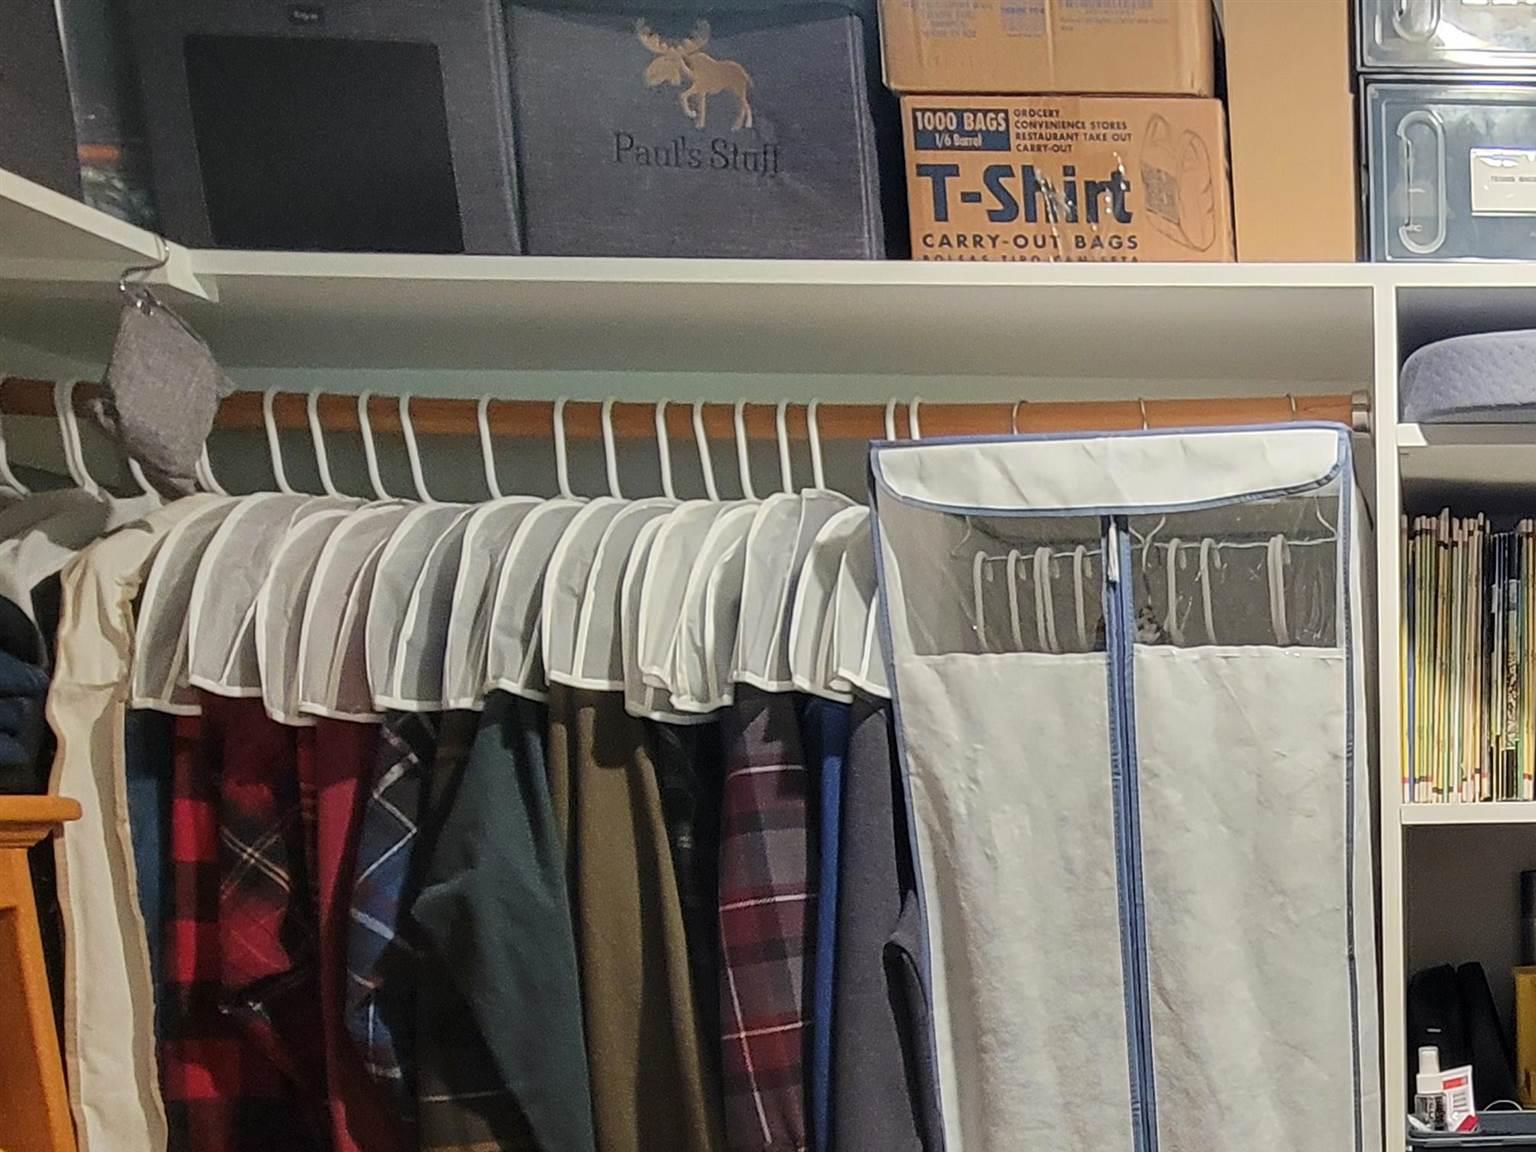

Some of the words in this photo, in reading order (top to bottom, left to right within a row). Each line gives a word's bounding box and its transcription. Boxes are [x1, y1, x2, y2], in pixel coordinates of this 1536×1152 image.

[1013, 109, 1060, 118] GROCERY
[915, 111, 957, 131] 1000
[963, 112, 1007, 132] BAGS
[1014, 120, 1086, 130] CONVENIENCE
[1090, 121, 1127, 130] STORES
[935, 133, 951, 148] 1/6
[1015, 131, 1080, 142] RESTAURANT
[1082, 132, 1107, 142] TAKE
[1110, 132, 1133, 142] OUT
[614, 131, 702, 168] Paul's
[710, 138, 780, 178] Stuff
[1016, 143, 1073, 153] CARRY-OUT
[915, 164, 1134, 224] T-Shirt
[922, 234, 1060, 249] CARRY-OUT
[1074, 234, 1138, 250] BAGS
